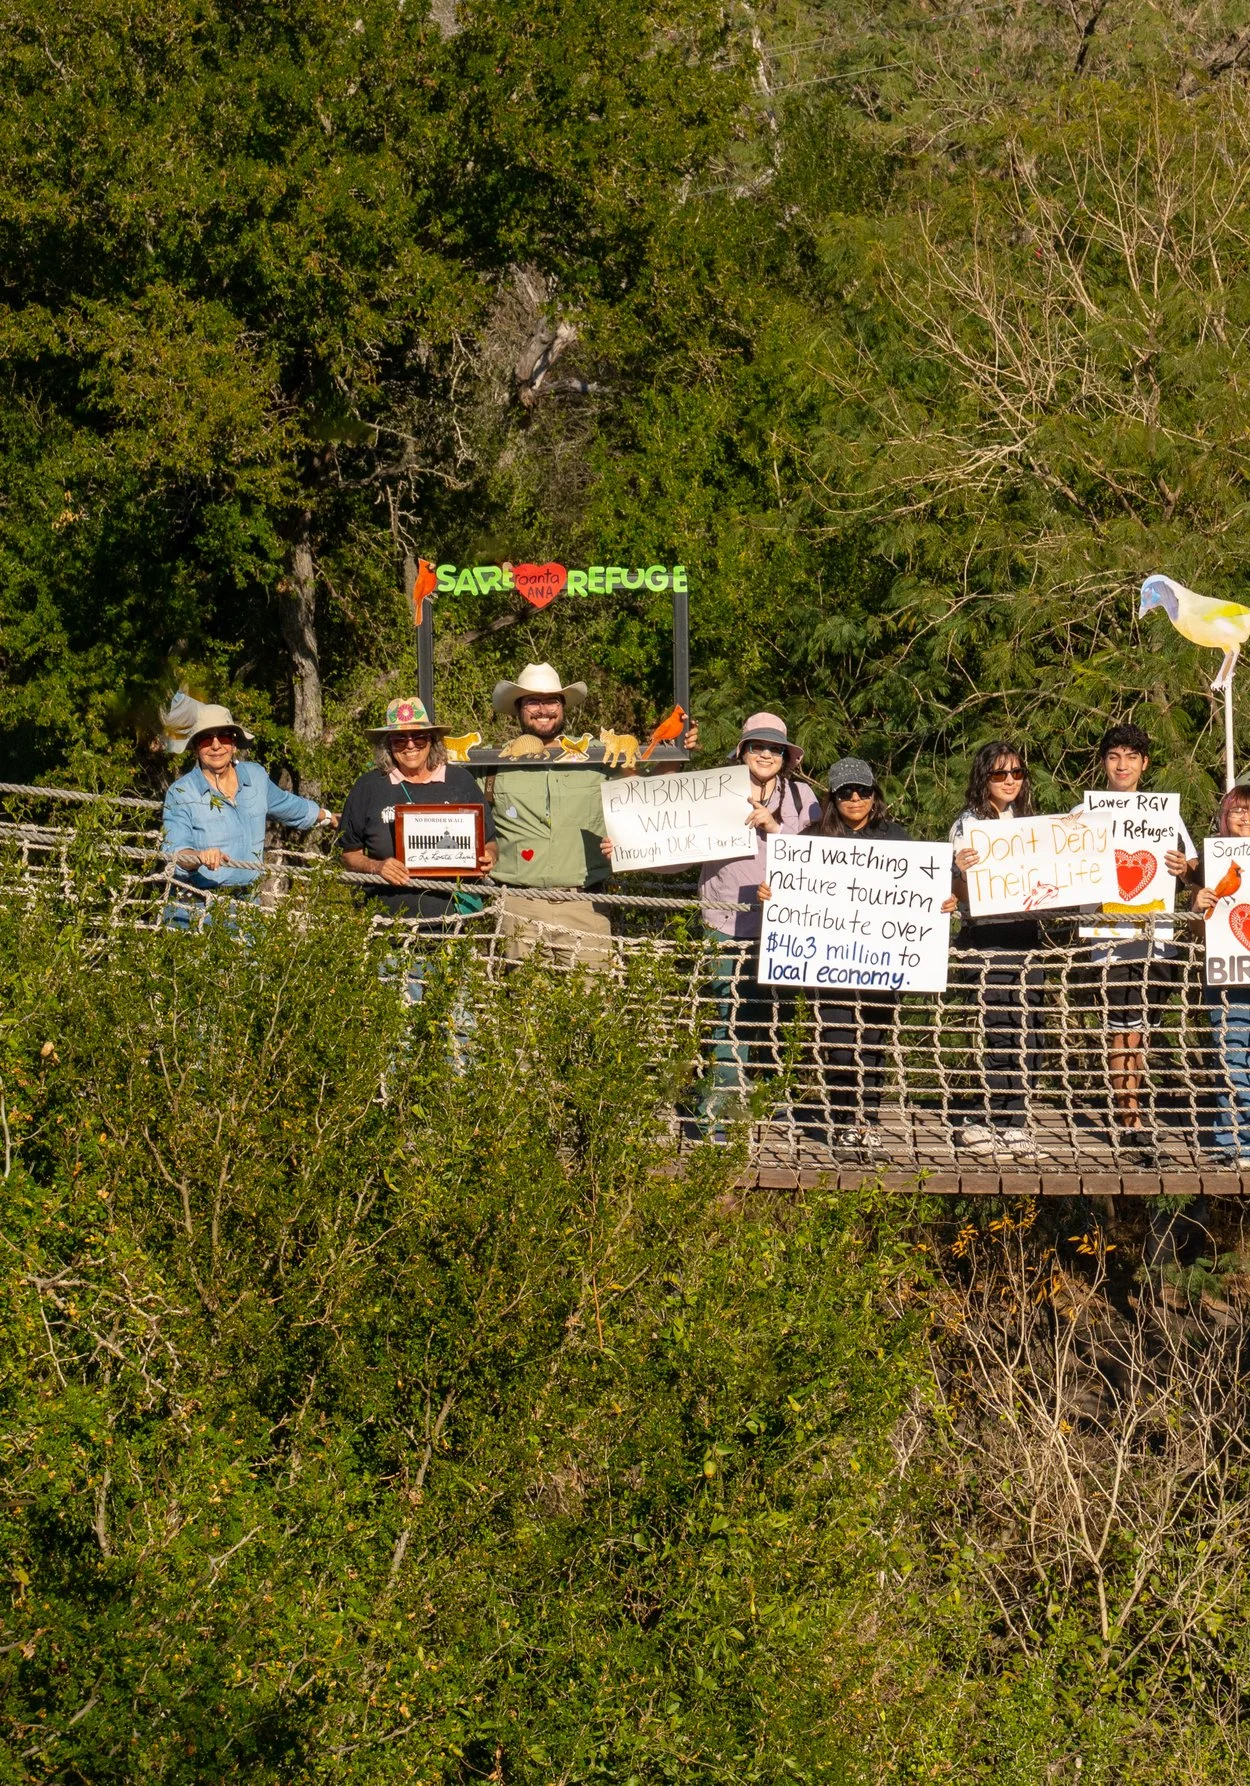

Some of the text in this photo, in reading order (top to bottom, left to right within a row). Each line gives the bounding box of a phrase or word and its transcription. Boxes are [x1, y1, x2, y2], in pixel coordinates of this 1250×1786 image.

[527, 586, 554, 599] ANA
[567, 565, 687, 598] REFUGE
[1088, 795, 1169, 811] Lower RGV
[637, 810, 708, 833] WALL
[1123, 820, 1175, 843] Refuges
[613, 842, 661, 862] Through
[667, 834, 699, 854] OUR
[774, 839, 813, 863] Bird
[822, 845, 909, 879] watching
[971, 827, 1039, 865] Don't
[1052, 824, 1107, 855] Deny
[769, 868, 933, 913] nature tourism
[970, 859, 1103, 902] Their Life
[767, 904, 933, 942] contribute over
[766, 931, 920, 968] $463 million to
[768, 958, 910, 991] local economy.
